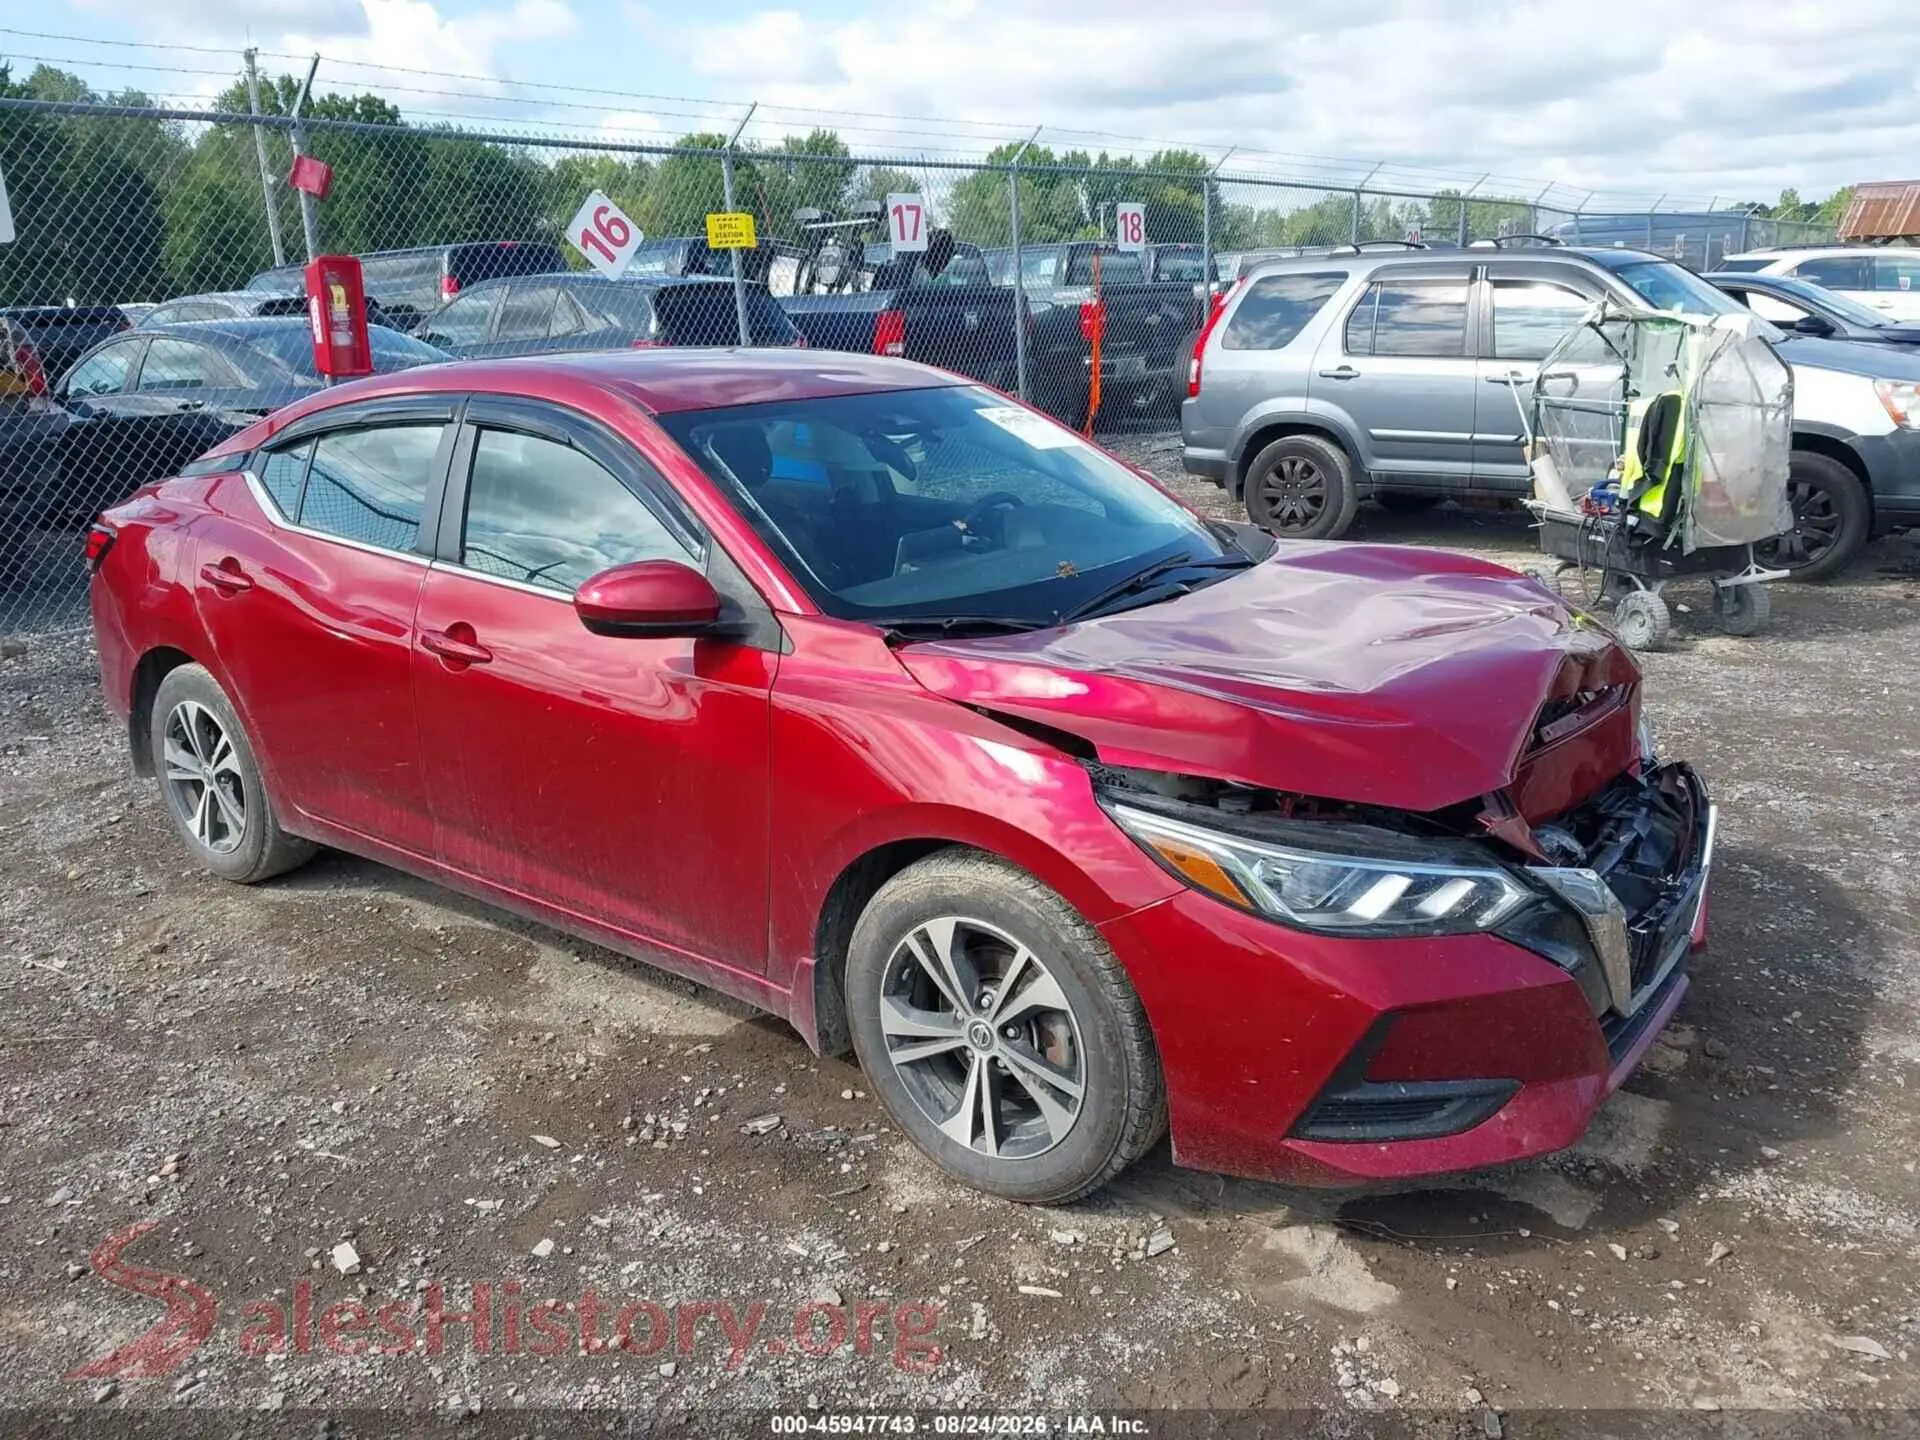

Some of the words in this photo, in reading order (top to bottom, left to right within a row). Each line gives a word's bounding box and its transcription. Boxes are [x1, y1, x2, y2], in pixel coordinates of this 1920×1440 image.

[581, 206, 630, 263] 16
[892, 205, 921, 241] 17
[1120, 212, 1142, 243] 18
